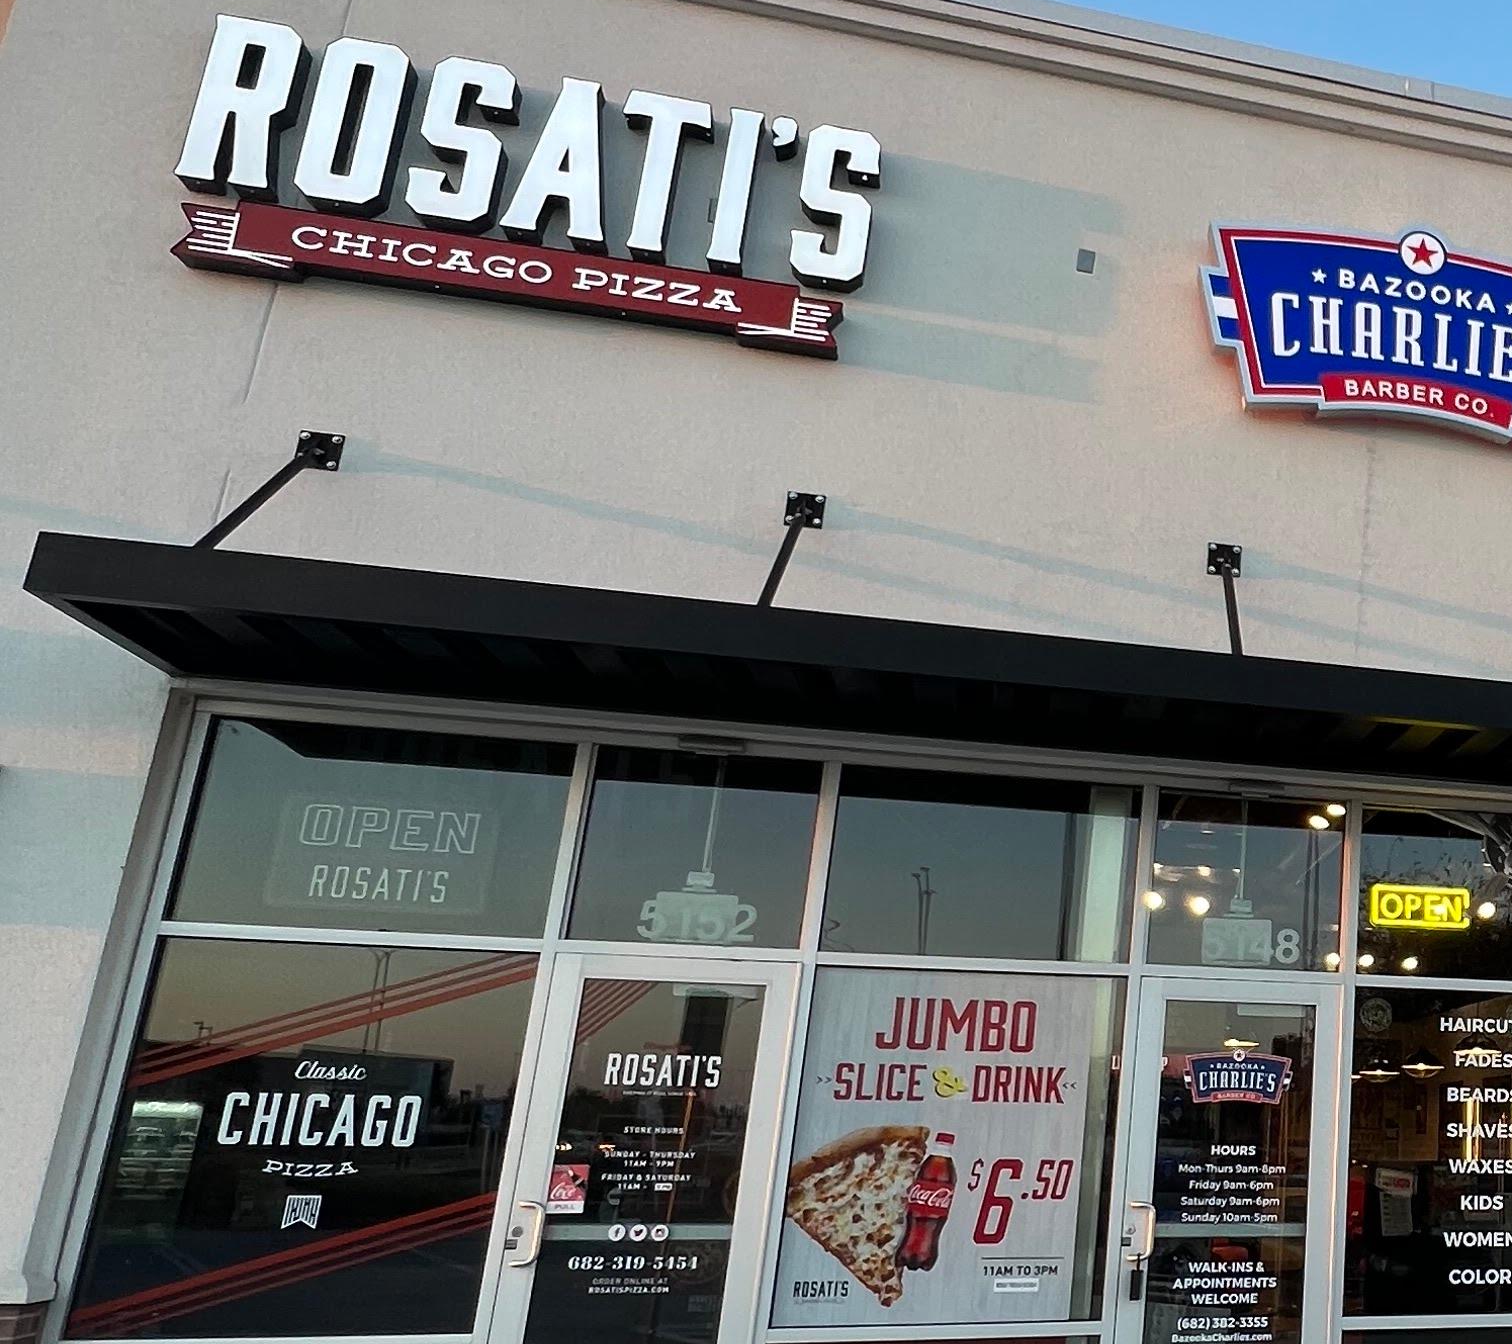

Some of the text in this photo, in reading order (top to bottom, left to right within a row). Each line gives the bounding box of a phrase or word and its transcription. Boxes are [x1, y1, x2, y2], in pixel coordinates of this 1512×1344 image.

[173, 13, 882, 289] ROSATI'S
[290, 226, 743, 314] CHICAGO PIZZA
[1338, 268, 1497, 314] BAZOOKA
[1344, 378, 1495, 418] BARBER CO.
[299, 803, 482, 855] OPEN
[308, 863, 450, 904] ROSATI'S
[1378, 891, 1463, 924] OPEN
[637, 899, 758, 944] 5152
[875, 996, 1038, 1054] JUMBO
[294, 1060, 368, 1082] Classic
[603, 1053, 723, 1088] ROSATI'S
[833, 1062, 1067, 1104] SLICE & DRINK
[1199, 1070, 1277, 1093] CHARLIE'S
[217, 1091, 424, 1149] CHICAGO
[654, 1127, 685, 1135] HOURS
[604, 1150, 641, 1158] SUNDAY
[649, 1151, 696, 1159] THURSDAY
[1210, 1145, 1257, 1156] HOURS
[261, 1159, 360, 1178] PIZZA
[1178, 1163, 1234, 1174] Mon-Thurs
[601, 1173, 634, 1181] FRIDAY
[645, 1173, 692, 1182] SATURDAY
[1188, 1180, 1274, 1192] Friday 9am-6pm
[967, 1158, 1075, 1245] $6.50
[1180, 1196, 1280, 1208] Saturday 9am-6pm
[1460, 1194, 1504, 1211] KIDS
[1181, 1212, 1278, 1225] Sunday 10am-5pm
[568, 1256, 699, 1271] 682-319-5454
[983, 1265, 1059, 1276] 11AM TO 3PM
[1188, 1261, 1265, 1273] WALK-INS &
[624, 1277, 656, 1285] ONLINE
[1172, 1277, 1278, 1289] APPOINTMENTS
[1448, 1268, 1512, 1285] COLOR
[792, 1280, 850, 1298] ROSATI'S
[1191, 1292, 1259, 1305] WELCOME
[1177, 1317, 1211, 1331] (682)
